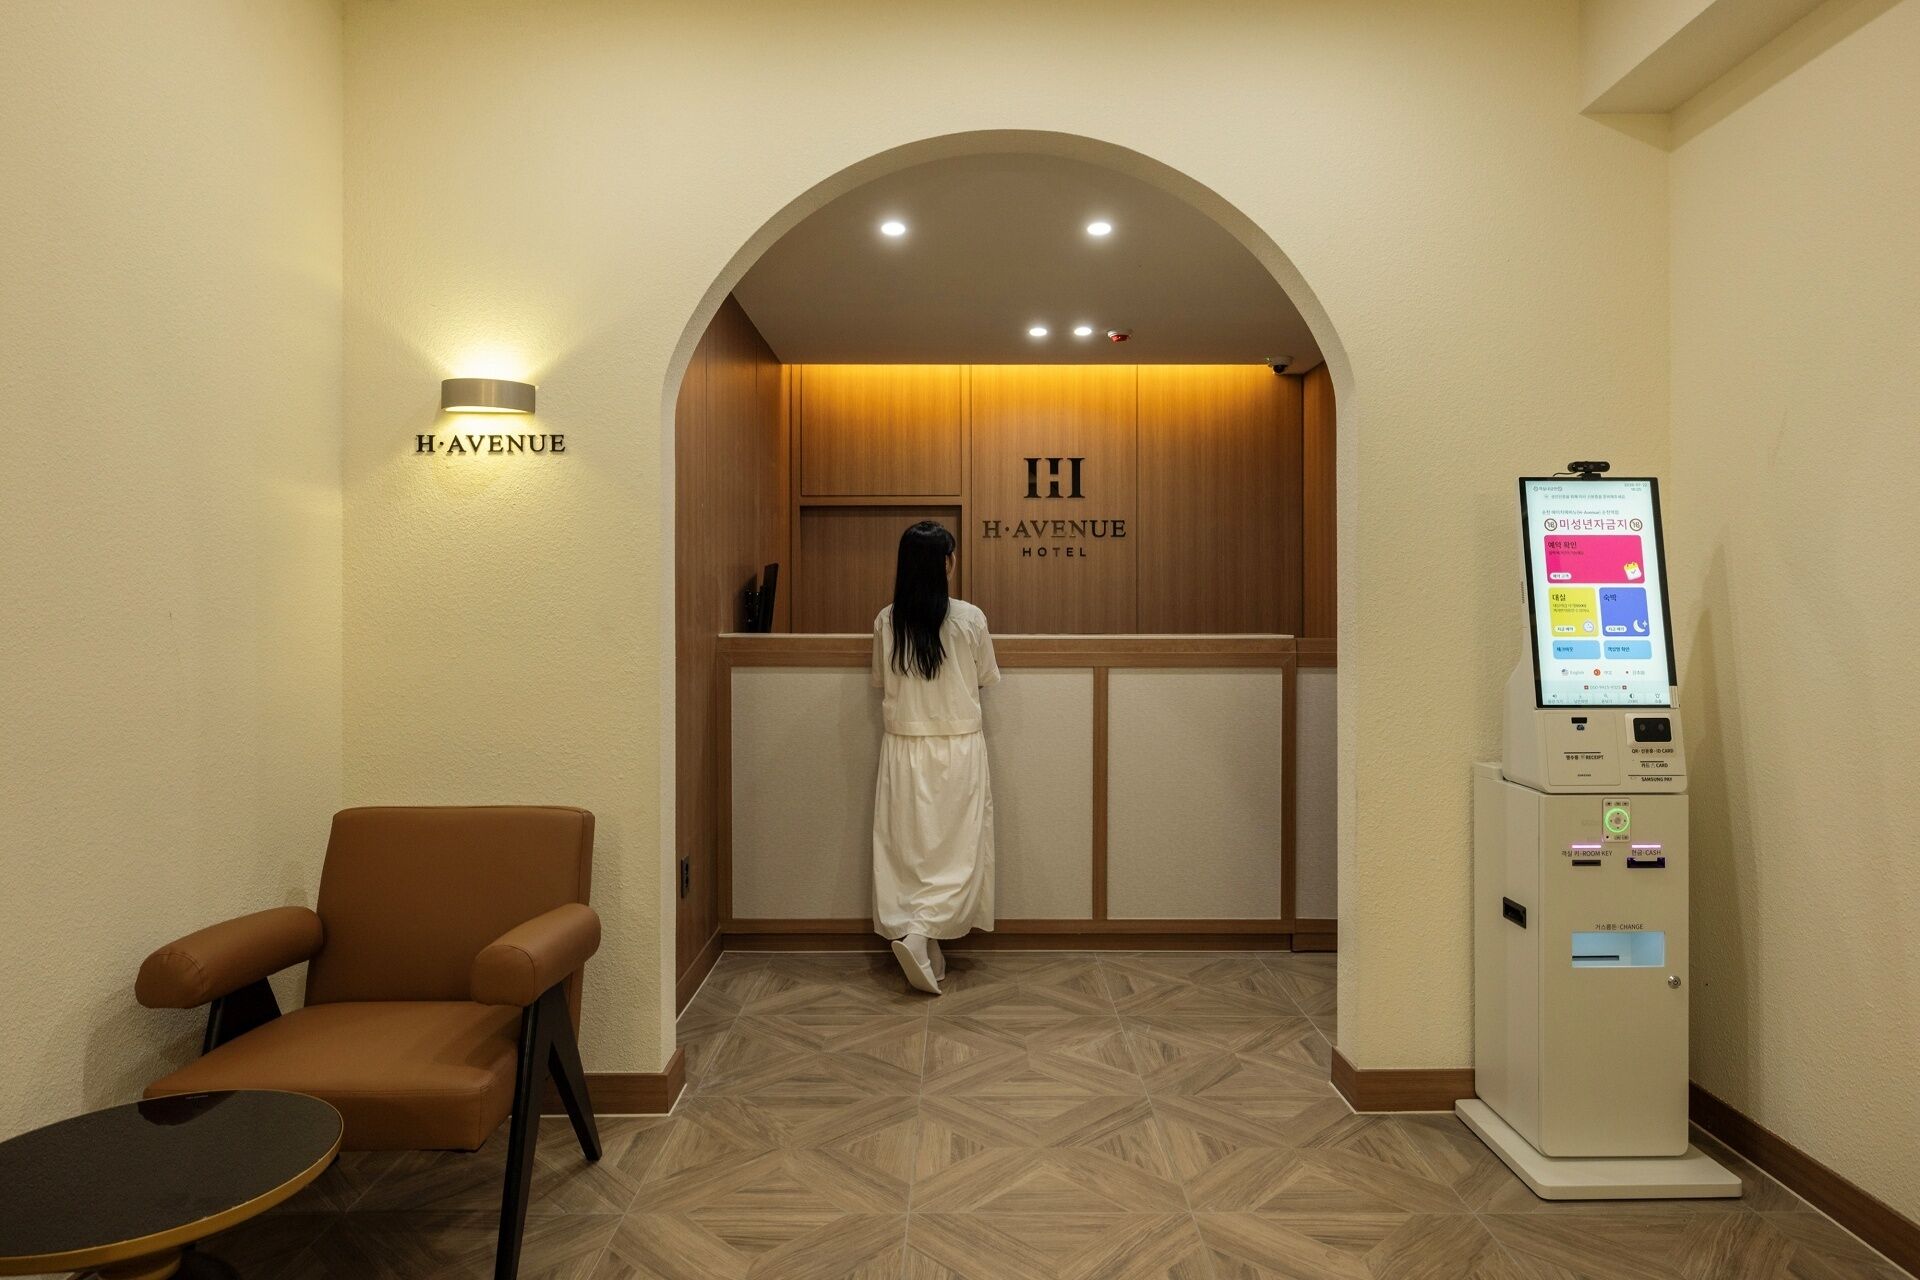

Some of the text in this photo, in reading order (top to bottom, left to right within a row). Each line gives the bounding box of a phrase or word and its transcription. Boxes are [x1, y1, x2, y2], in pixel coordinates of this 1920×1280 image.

[1559, 518, 1628, 530] 미성년자금지
[1547, 541, 1577, 549] 예약 확인
[1022, 547, 1087, 557] HOTEL
